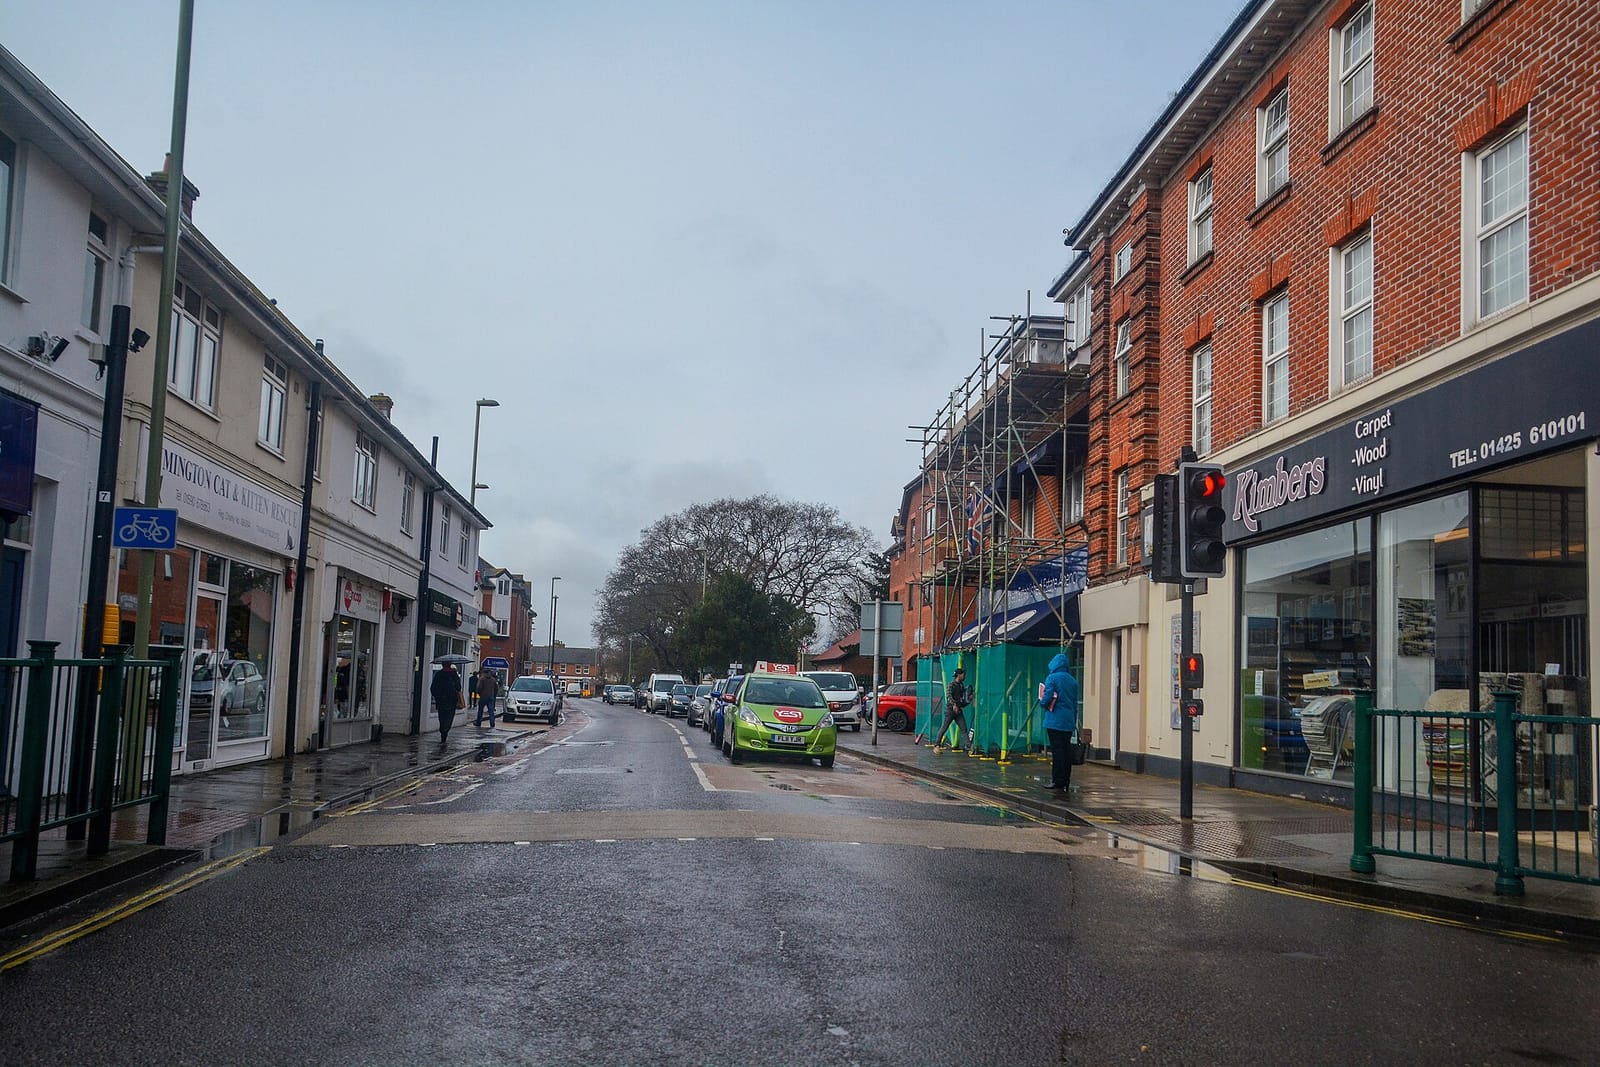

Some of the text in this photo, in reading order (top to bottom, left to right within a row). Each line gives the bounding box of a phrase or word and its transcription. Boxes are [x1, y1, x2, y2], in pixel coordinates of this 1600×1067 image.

[1355, 409, 1392, 439] Carpet
[1351, 436, 1387, 467] -Wood
[1450, 411, 1585, 468] TEL: 01425 610101
[1232, 456, 1325, 532] Kimbers
[1351, 467, 1384, 495] -Vinyl
[101, 492, 108, 501] 7
[213, 474, 231, 499] CAT
[232, 483, 239, 502] &
[241, 487, 269, 515] KITTEN
[271, 501, 298, 529] RESCUE
[775, 709, 803, 719] YES!
